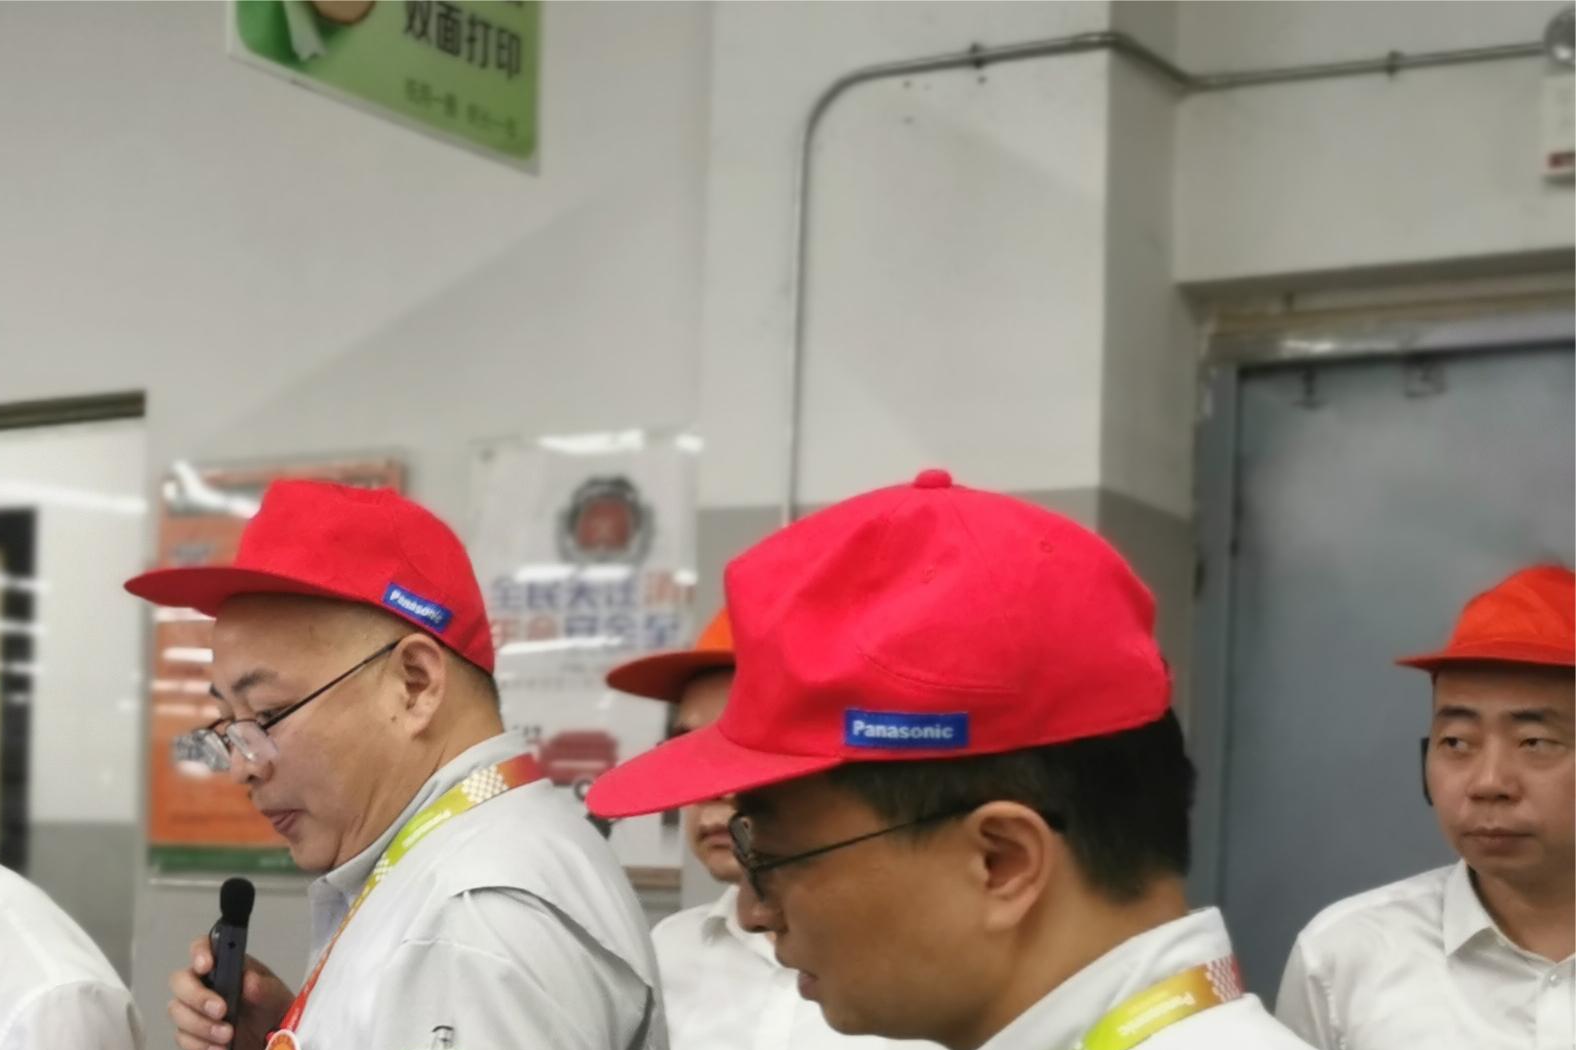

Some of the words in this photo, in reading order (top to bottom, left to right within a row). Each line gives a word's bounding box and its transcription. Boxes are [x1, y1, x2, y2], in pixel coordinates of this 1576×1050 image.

[403, 0, 522, 79] 双面打印
[389, 588, 444, 624] Panasonic
[852, 720, 954, 739] Panasonic
